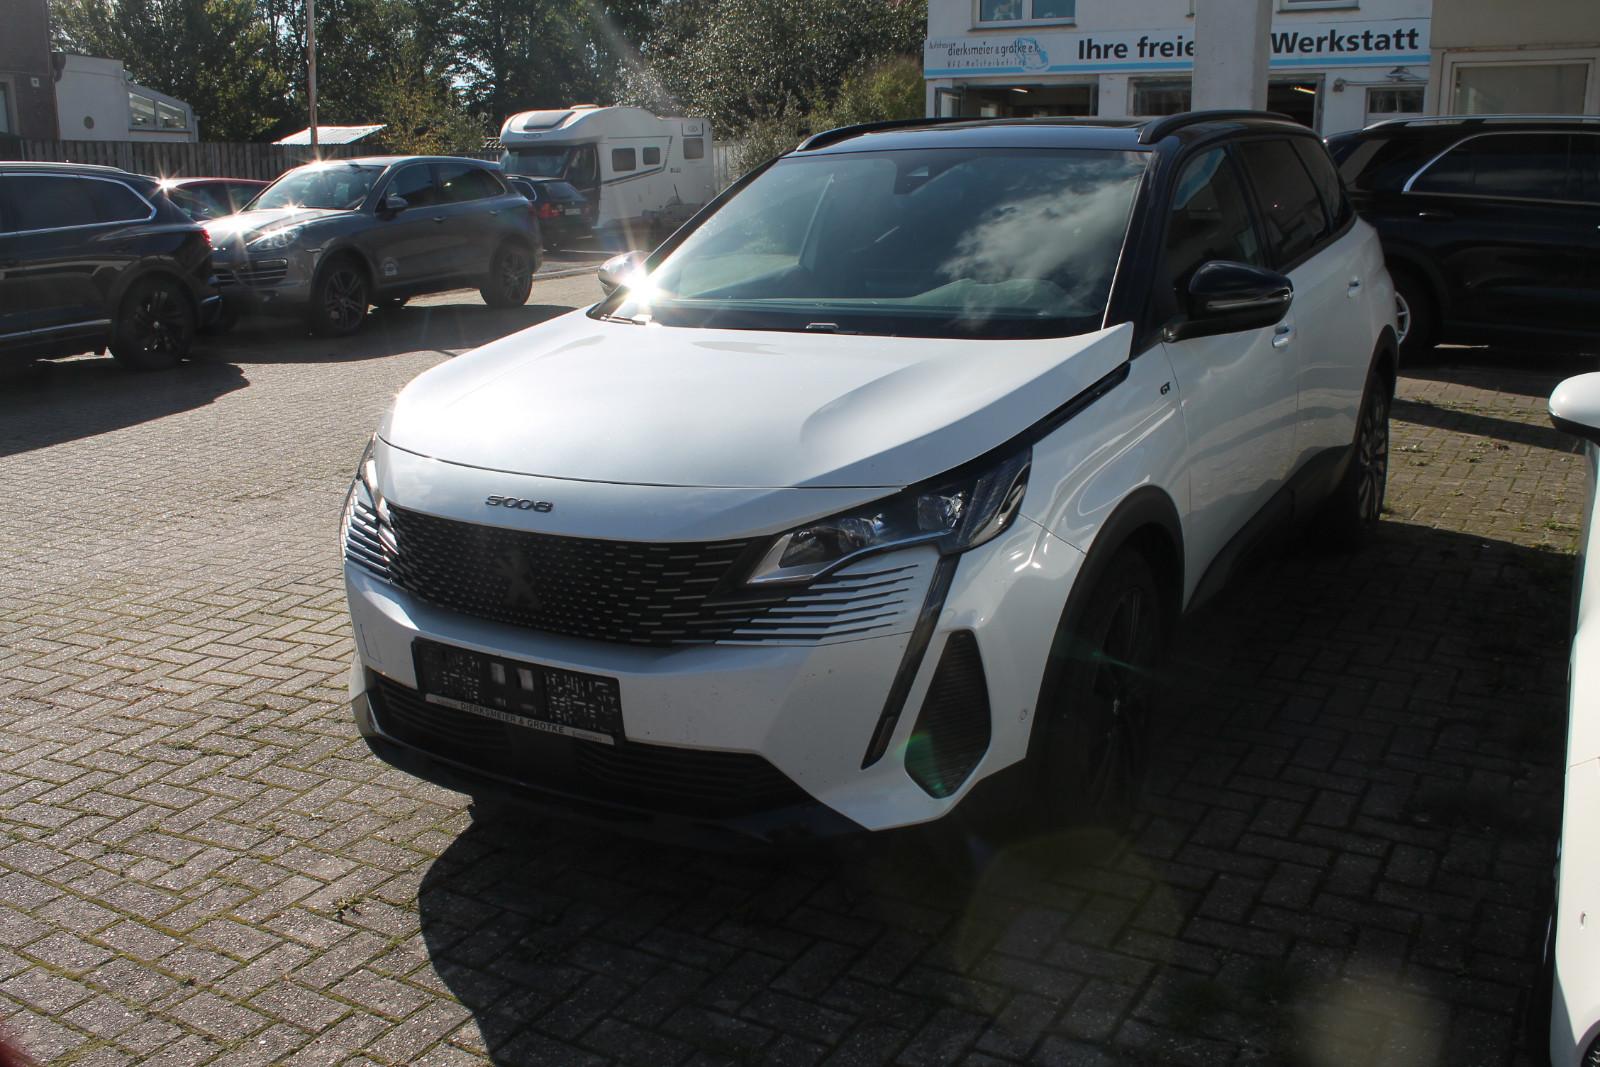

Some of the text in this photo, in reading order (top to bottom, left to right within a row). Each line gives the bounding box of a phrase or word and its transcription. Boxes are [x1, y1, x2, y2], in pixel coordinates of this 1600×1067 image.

[1078, 38, 1128, 60] Ihre
[1271, 28, 1419, 54] Werkstatt
[485, 494, 554, 513] 5008
[527, 719, 565, 734] GROTKE
